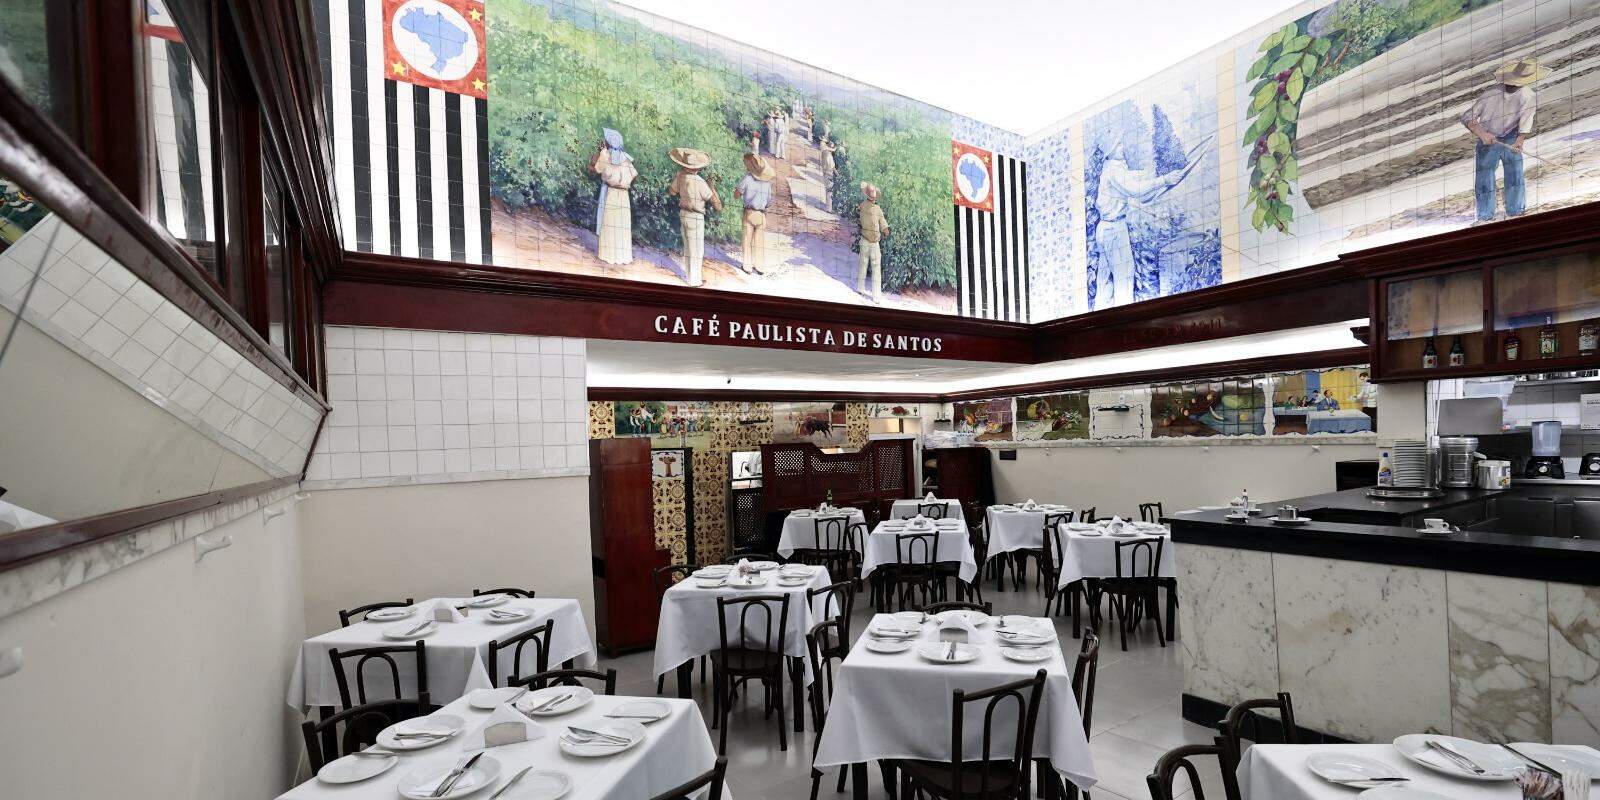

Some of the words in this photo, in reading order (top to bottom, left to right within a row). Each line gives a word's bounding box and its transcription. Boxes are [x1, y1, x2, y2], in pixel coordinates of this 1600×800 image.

[654, 314, 721, 337] CAFÉ
[729, 321, 836, 346] PAULISTA
[843, 330, 868, 348] DE
[872, 333, 942, 352] SANTOS
